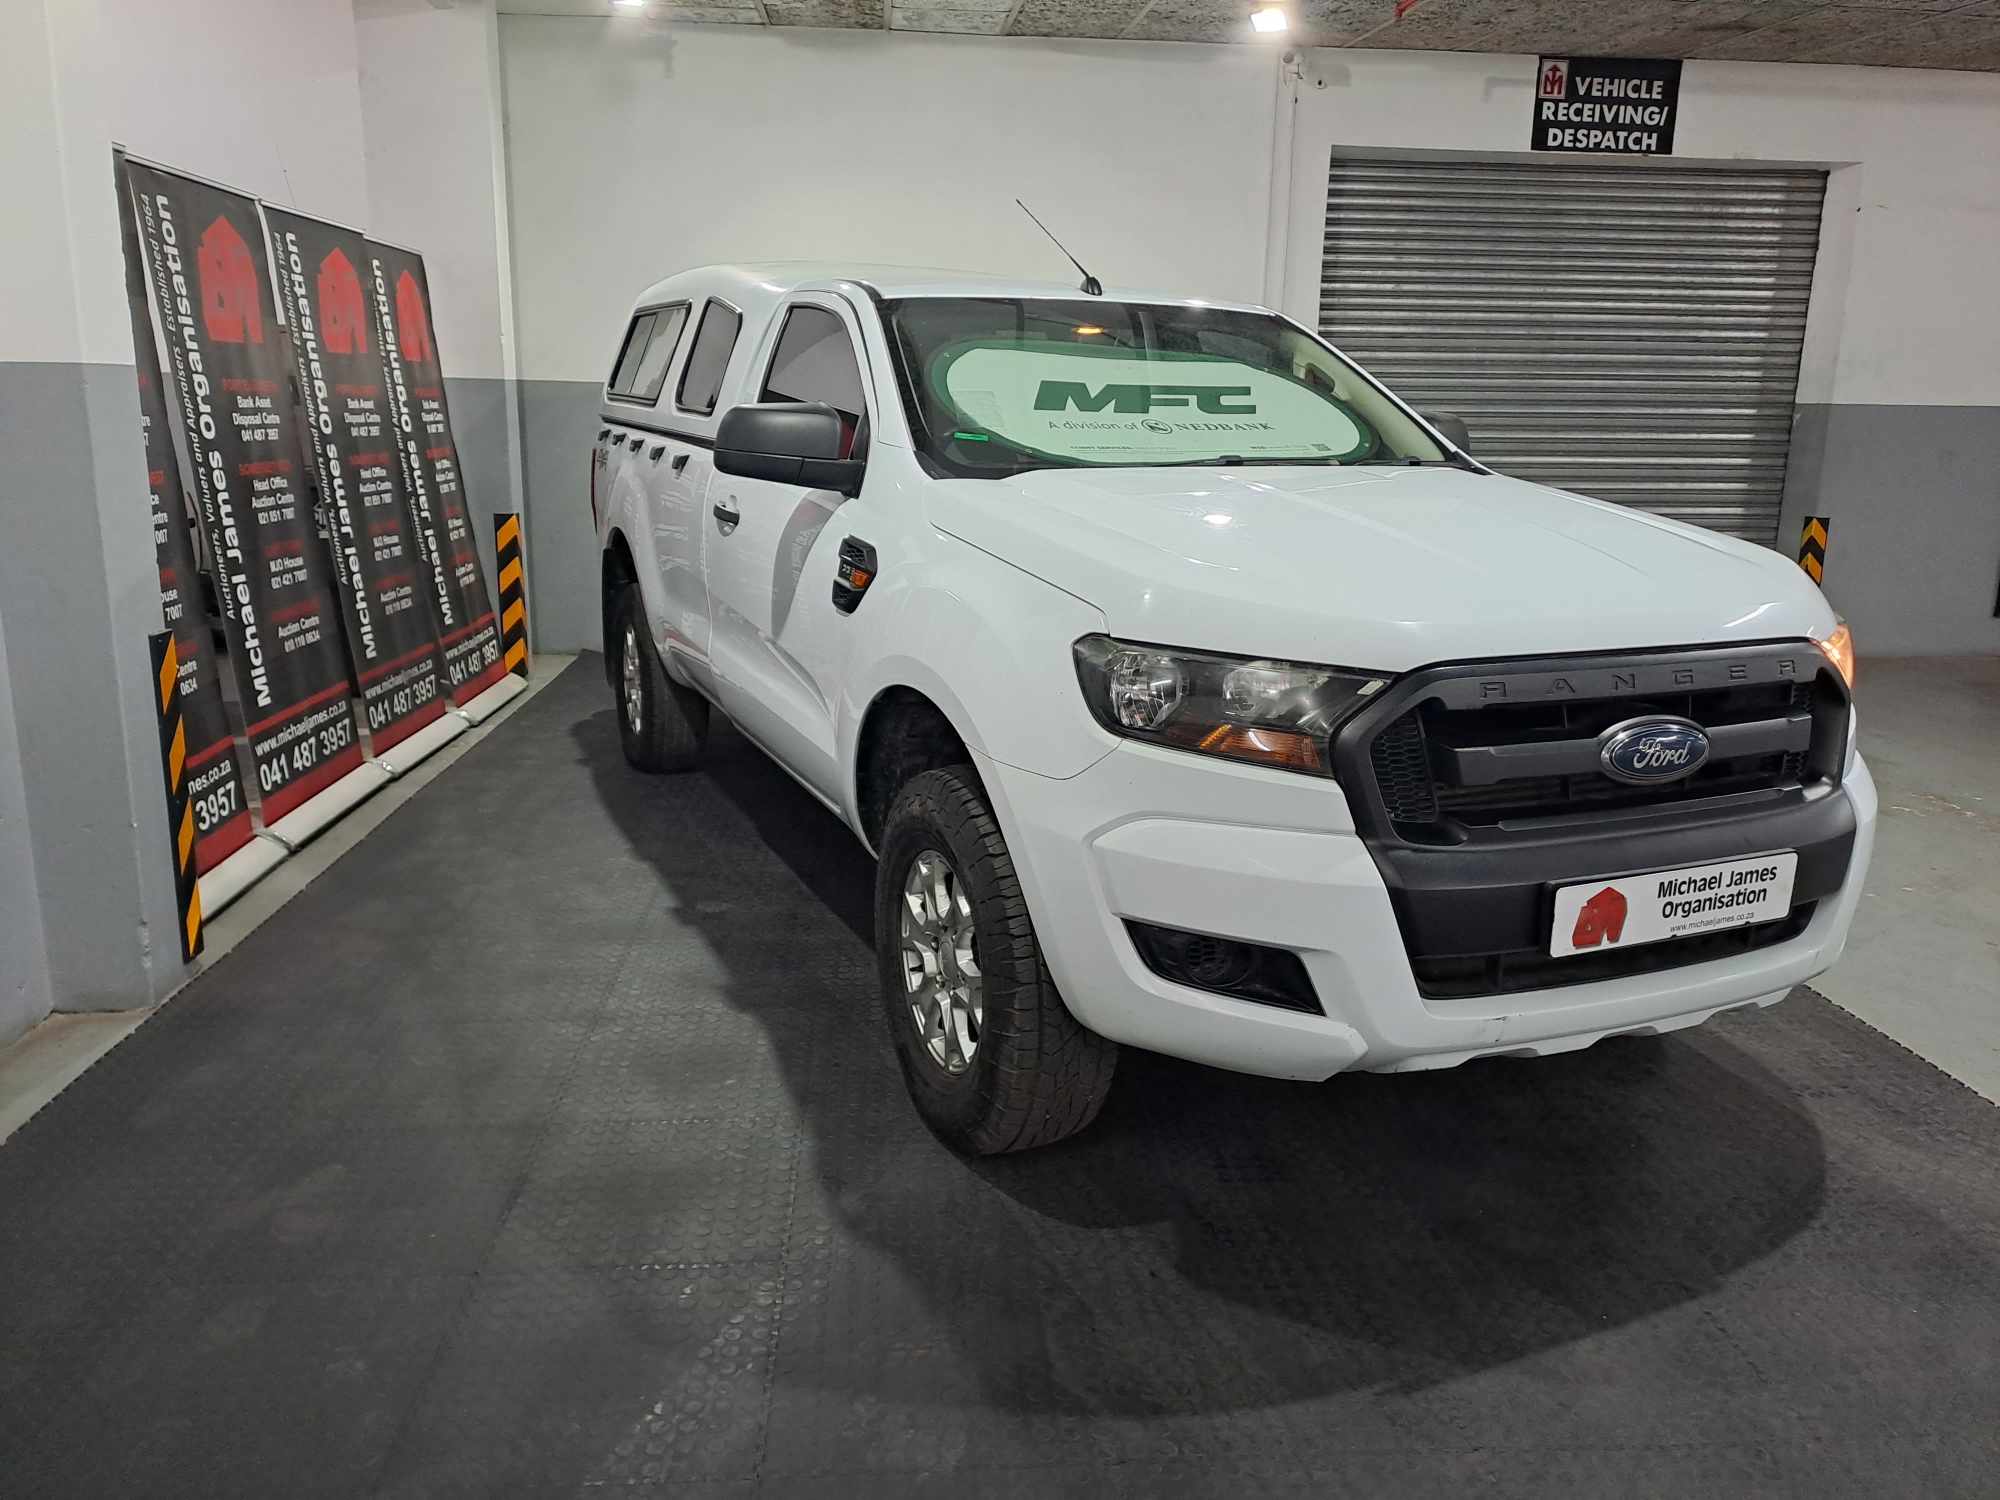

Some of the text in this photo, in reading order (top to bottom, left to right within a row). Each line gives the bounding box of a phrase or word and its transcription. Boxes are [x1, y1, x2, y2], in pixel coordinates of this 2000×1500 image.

[1575, 76, 1664, 100] VEHICLE
[1541, 101, 1669, 127] RECEIVING/
[1546, 127, 1659, 151] DESPATCH
[140, 193, 158, 235] 1964
[149, 237, 176, 332] Established
[371, 259, 412, 433] Organisation
[173, 345, 200, 429] Appraisers
[1033, 379, 1257, 415] MFC
[285, 231, 377, 660] Michael James Organisation
[310, 427, 322, 453] and
[1048, 420, 1277, 431] A division of NEDBANK
[156, 194, 272, 708] Michael James Organisation
[188, 432, 203, 463] and
[197, 466, 216, 523] Valuers
[407, 439, 431, 522] James
[160, 588, 178, 602] ouse
[423, 528, 454, 625] Michael
[449, 659, 468, 685] 041
[1479, 659, 1796, 699] RANGER
[369, 673, 437, 729] 041 487 3957
[260, 717, 351, 792] 041 487 3957
[1633, 737, 1691, 769] Ford
[195, 780, 236, 831] 3957
[1657, 865, 1778, 899] Michael James
[1662, 887, 1768, 919] Organisation
